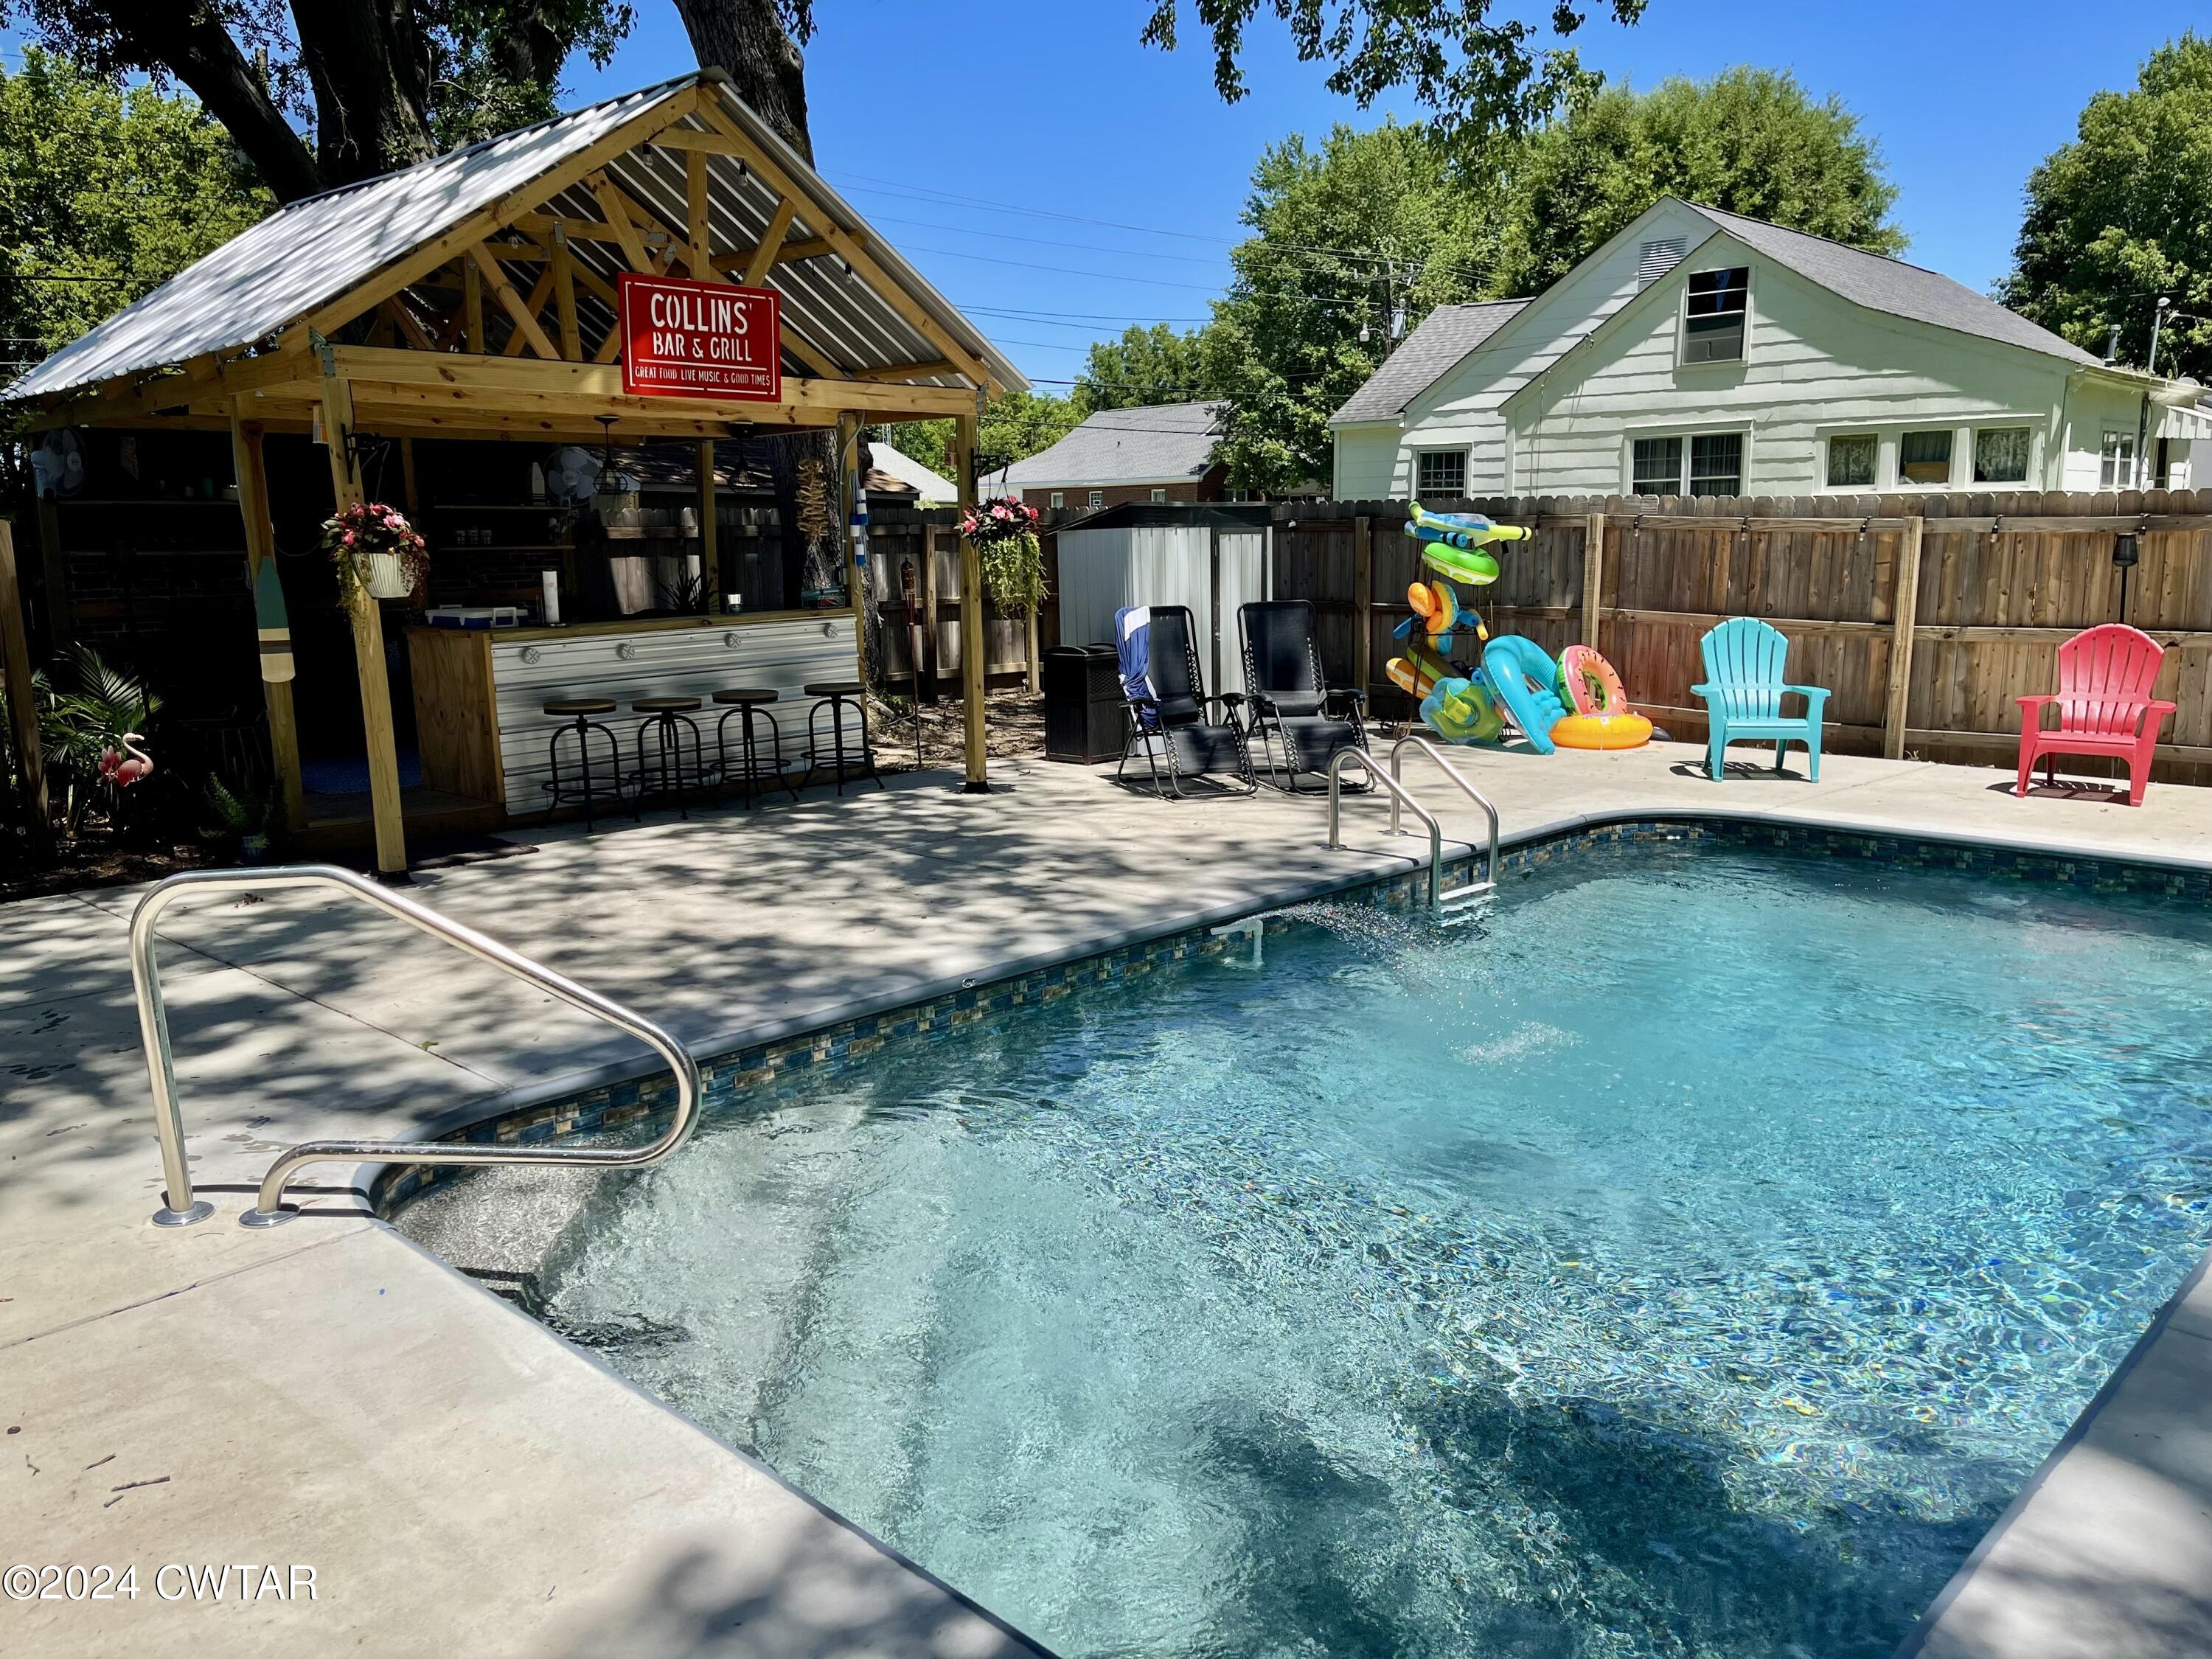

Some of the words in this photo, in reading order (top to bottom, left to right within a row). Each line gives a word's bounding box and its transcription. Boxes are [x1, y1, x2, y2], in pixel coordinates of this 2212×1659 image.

[651, 293, 752, 334] COLLINS'
[653, 332, 685, 356] BAR
[692, 338, 703, 358] &
[710, 337, 752, 361] GRILL
[635, 366, 656, 378] GREAT
[681, 369, 696, 380] LIVE
[724, 374, 728, 383] &
[731, 372, 748, 384] GOOD
[751, 374, 770, 386] TIMES
